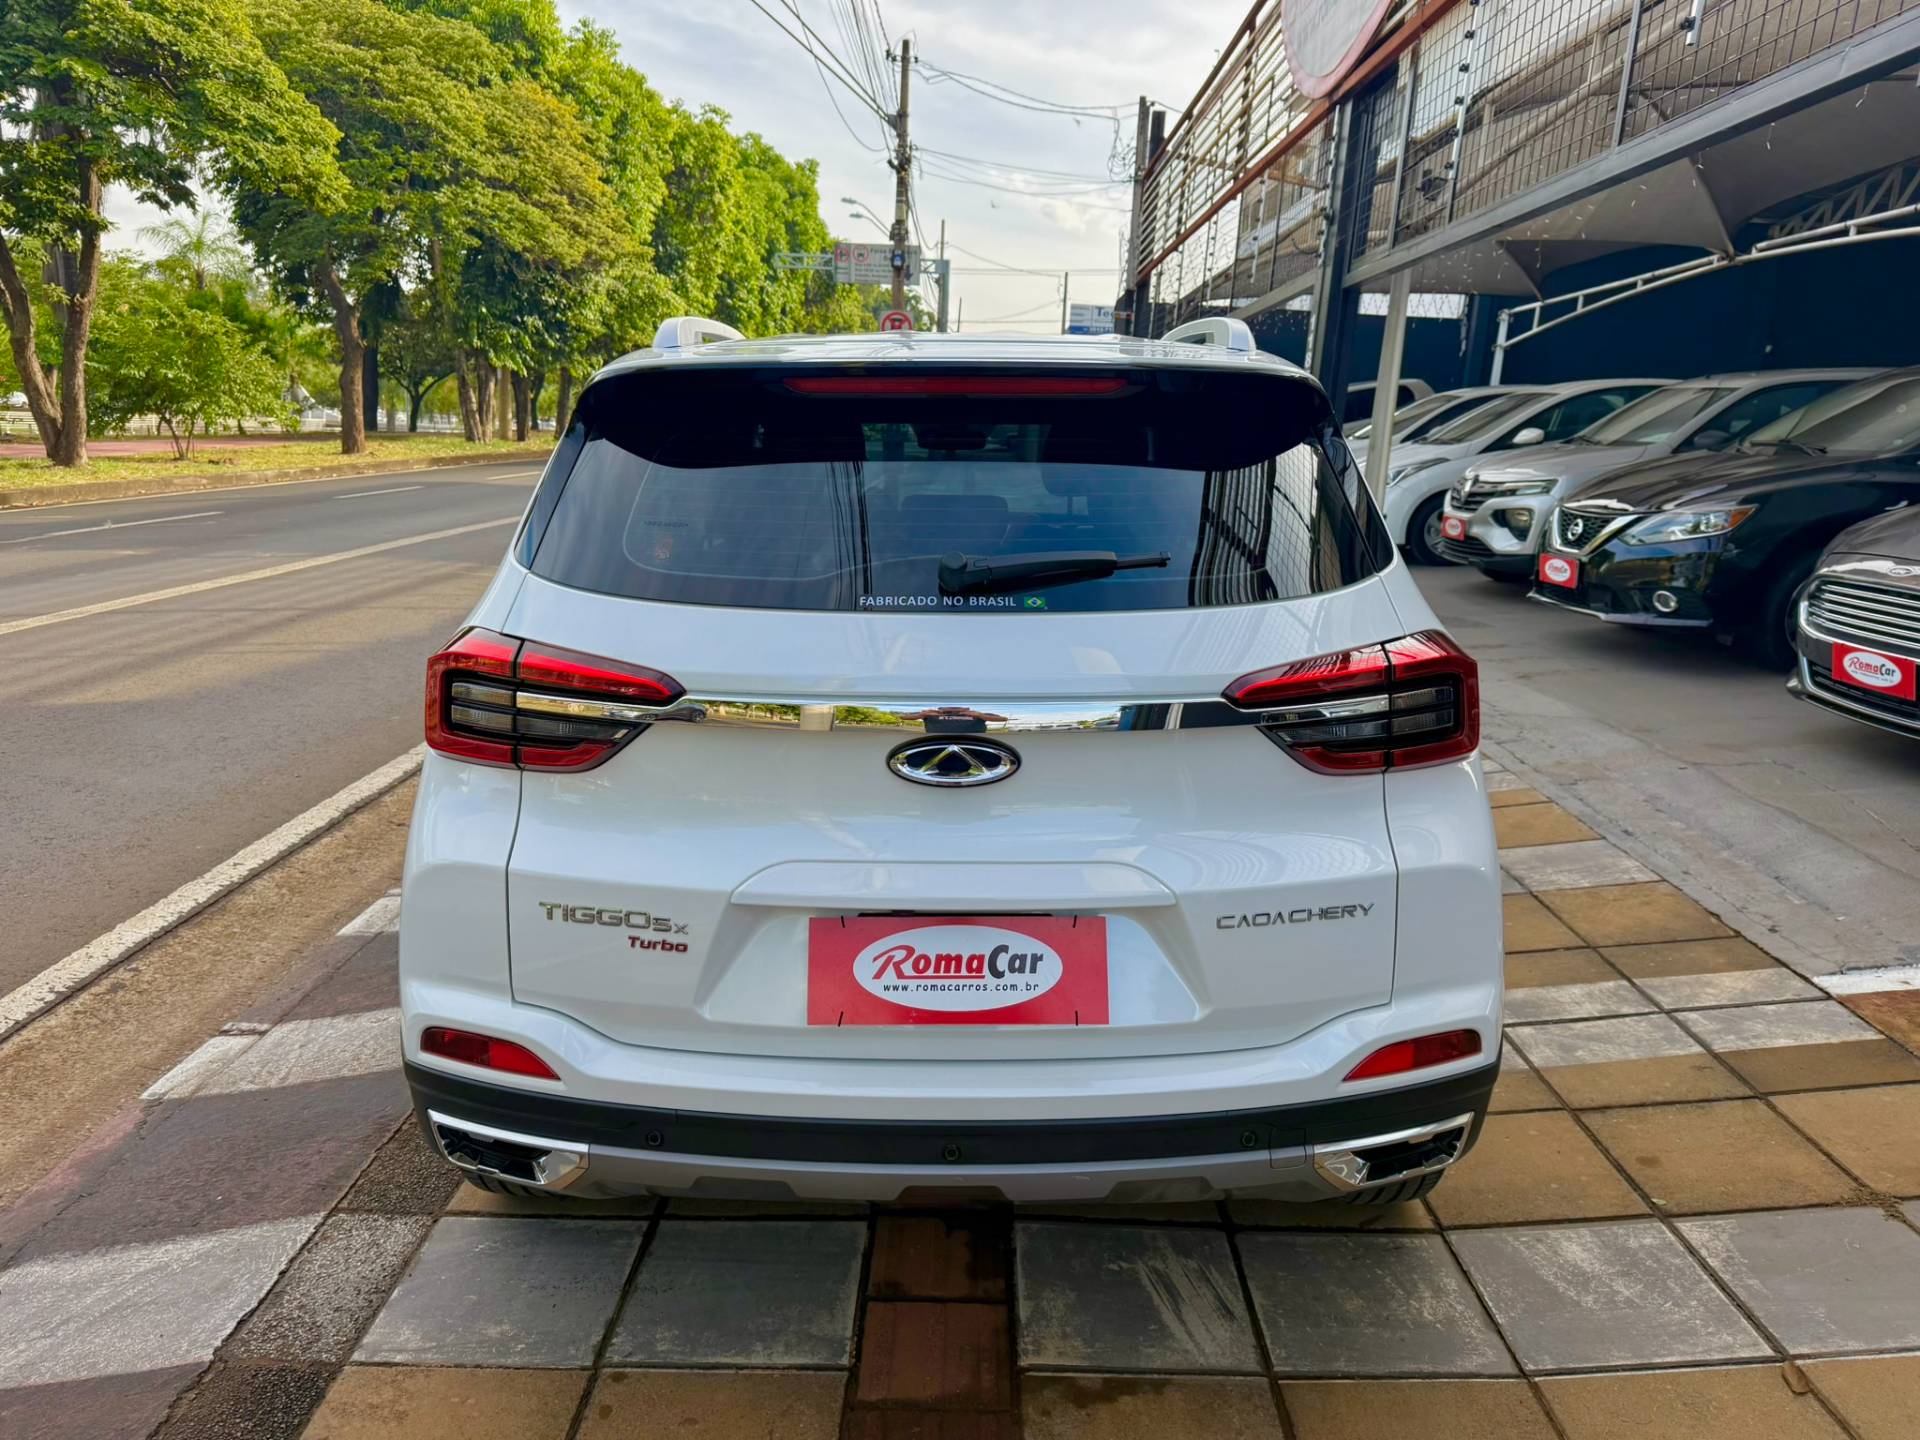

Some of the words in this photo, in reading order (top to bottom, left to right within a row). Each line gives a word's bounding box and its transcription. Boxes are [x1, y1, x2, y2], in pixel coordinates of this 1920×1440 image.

[859, 596, 937, 607] FABRICADO
[943, 596, 964, 607] NO
[969, 596, 1016, 607] BRASIL
[1848, 656, 1896, 677] RomaCar
[628, 935, 688, 953] Turbo
[872, 944, 1044, 980] RomaCar
[883, 982, 1039, 992] www.romacarros.com.br
